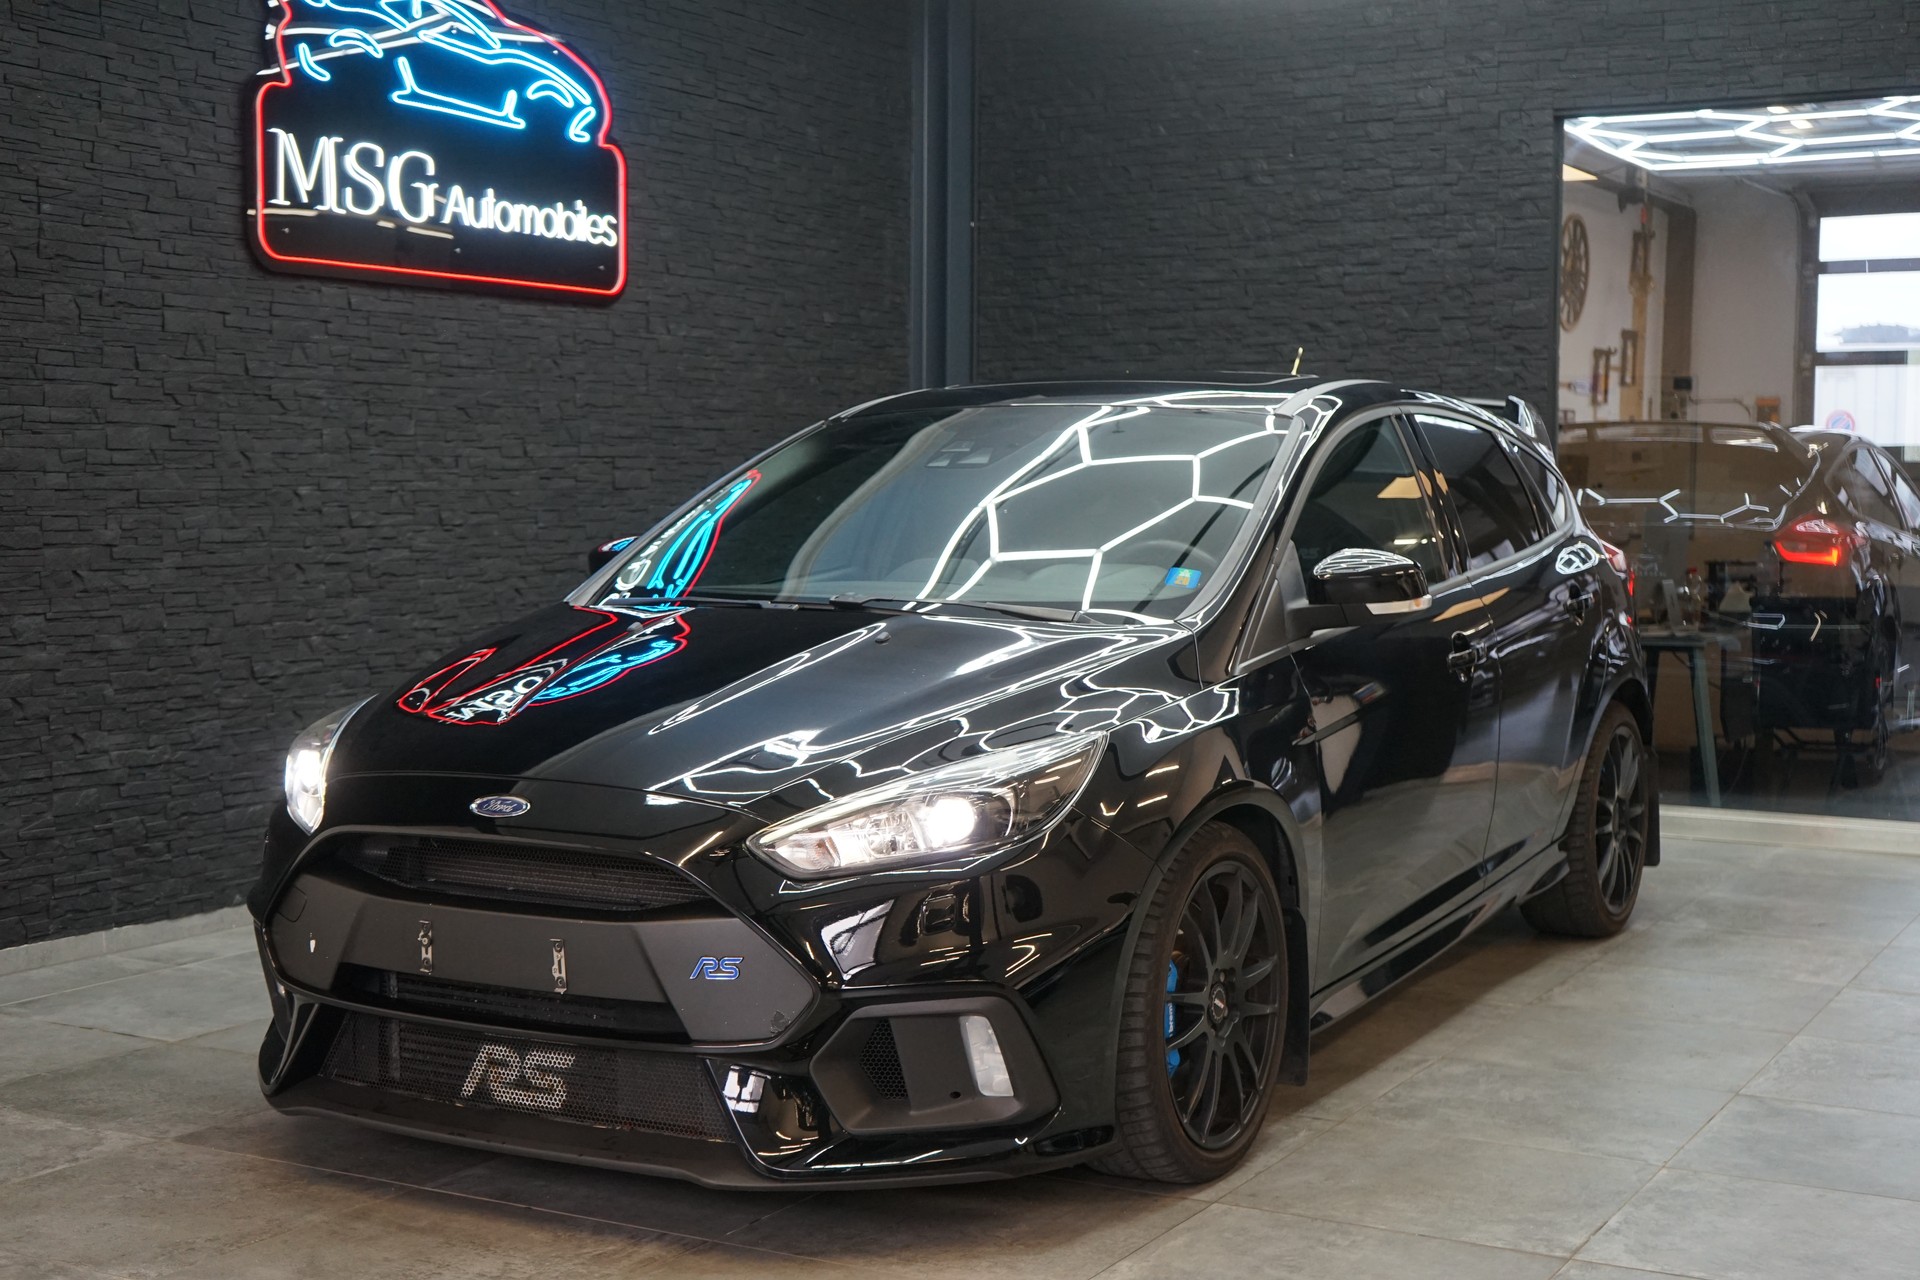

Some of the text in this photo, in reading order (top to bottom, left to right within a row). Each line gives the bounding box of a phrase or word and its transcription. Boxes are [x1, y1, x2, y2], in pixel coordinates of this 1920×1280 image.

[266, 127, 438, 224] MSG
[482, 800, 518, 812] Ford
[689, 956, 744, 980] RS
[460, 1044, 575, 1109] RS
